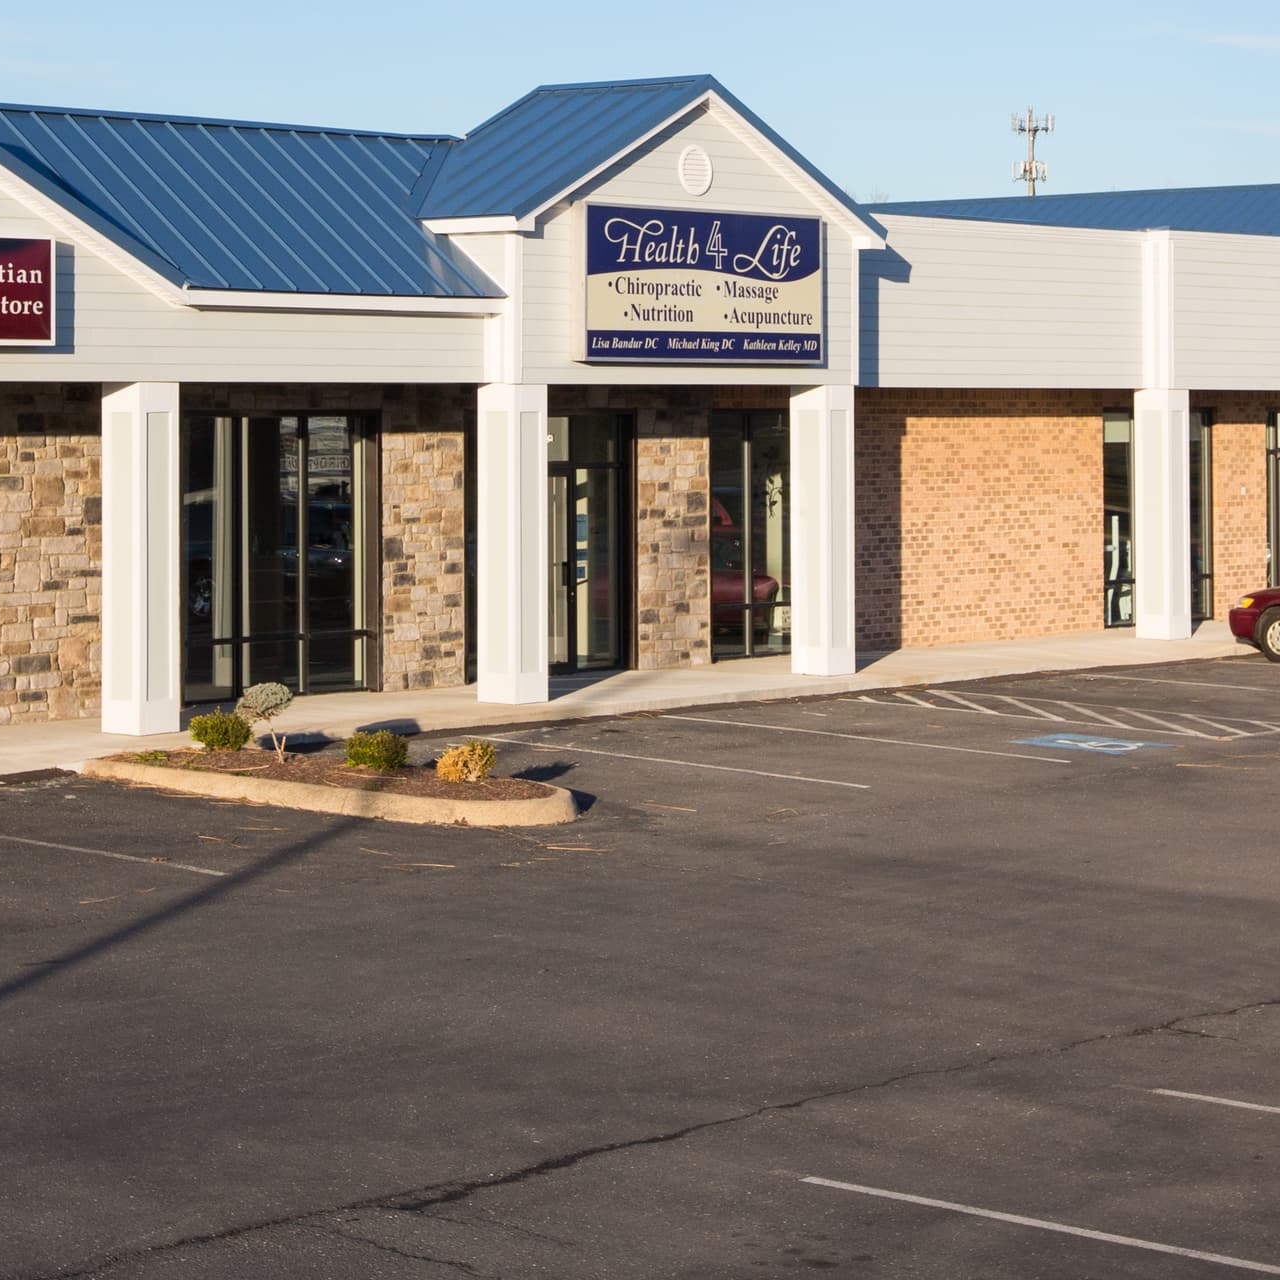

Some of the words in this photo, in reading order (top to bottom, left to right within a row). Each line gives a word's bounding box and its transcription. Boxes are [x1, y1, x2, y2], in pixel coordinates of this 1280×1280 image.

[604, 217, 699, 265] Health
[705, 221, 728, 269] 4
[733, 225, 801, 280] Life
[615, 276, 703, 300] Chiropractic
[723, 280, 780, 303] Massage
[630, 304, 694, 323] Nutrition
[730, 307, 813, 329] Acupuncture
[592, 337, 610, 349] Lisa
[644, 338, 659, 350] DC
[667, 337, 700, 350] Michael
[701, 338, 720, 353] King
[721, 338, 735, 350] DC
[743, 339, 777, 351] Kathleen
[778, 339, 801, 354] Kelley
[802, 339, 817, 351] MD
